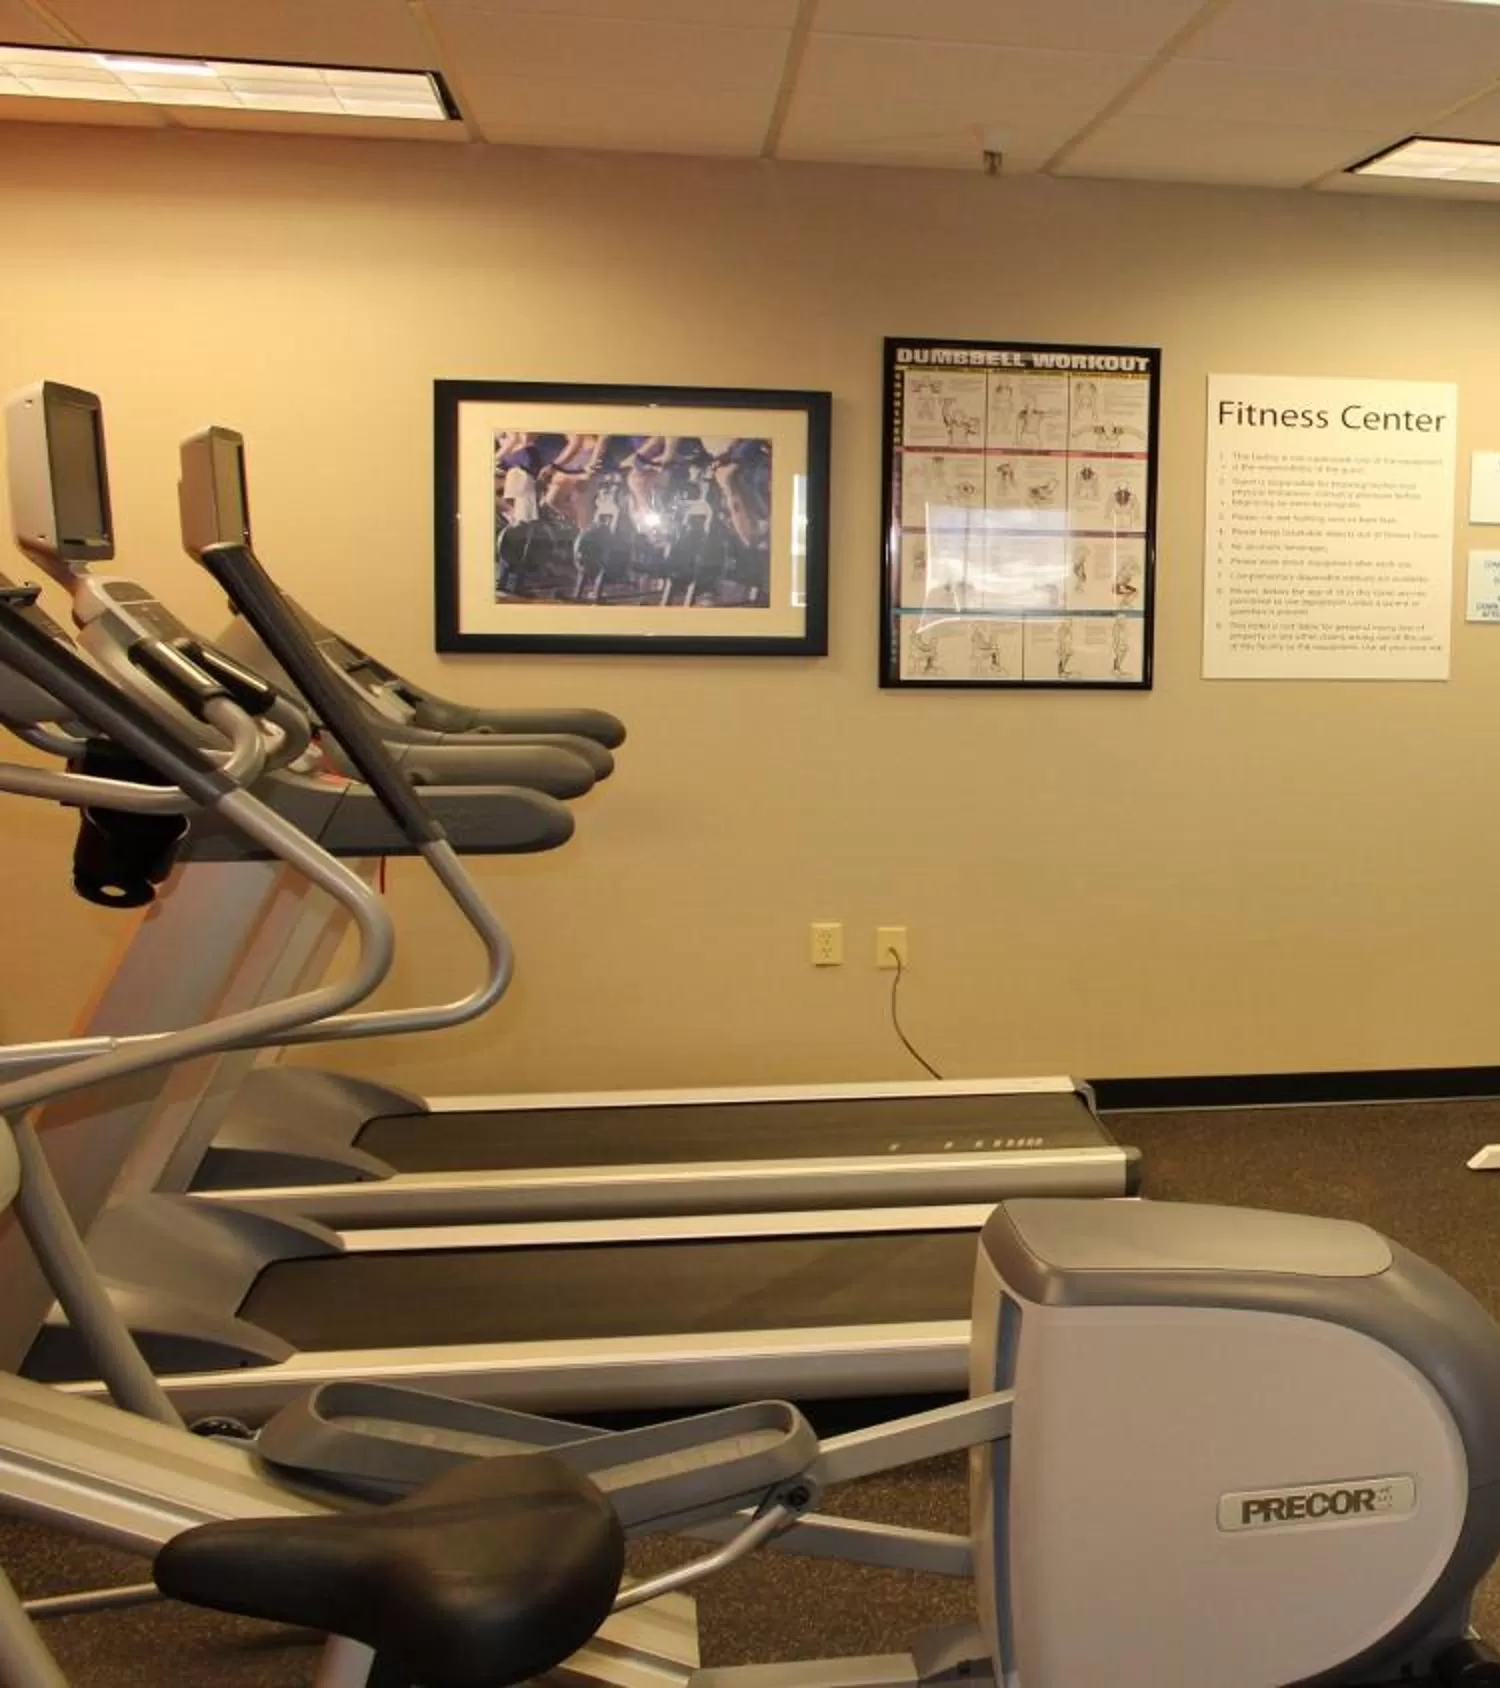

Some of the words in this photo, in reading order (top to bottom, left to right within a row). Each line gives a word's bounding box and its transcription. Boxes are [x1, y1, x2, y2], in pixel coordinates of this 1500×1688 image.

[896, 348, 1025, 368] DUMBBELL
[1032, 353, 1150, 372] WORKOUT
[1218, 400, 1329, 429] Fitness
[1340, 404, 1447, 432] Center
[1242, 1488, 1376, 1524] PRECOR
